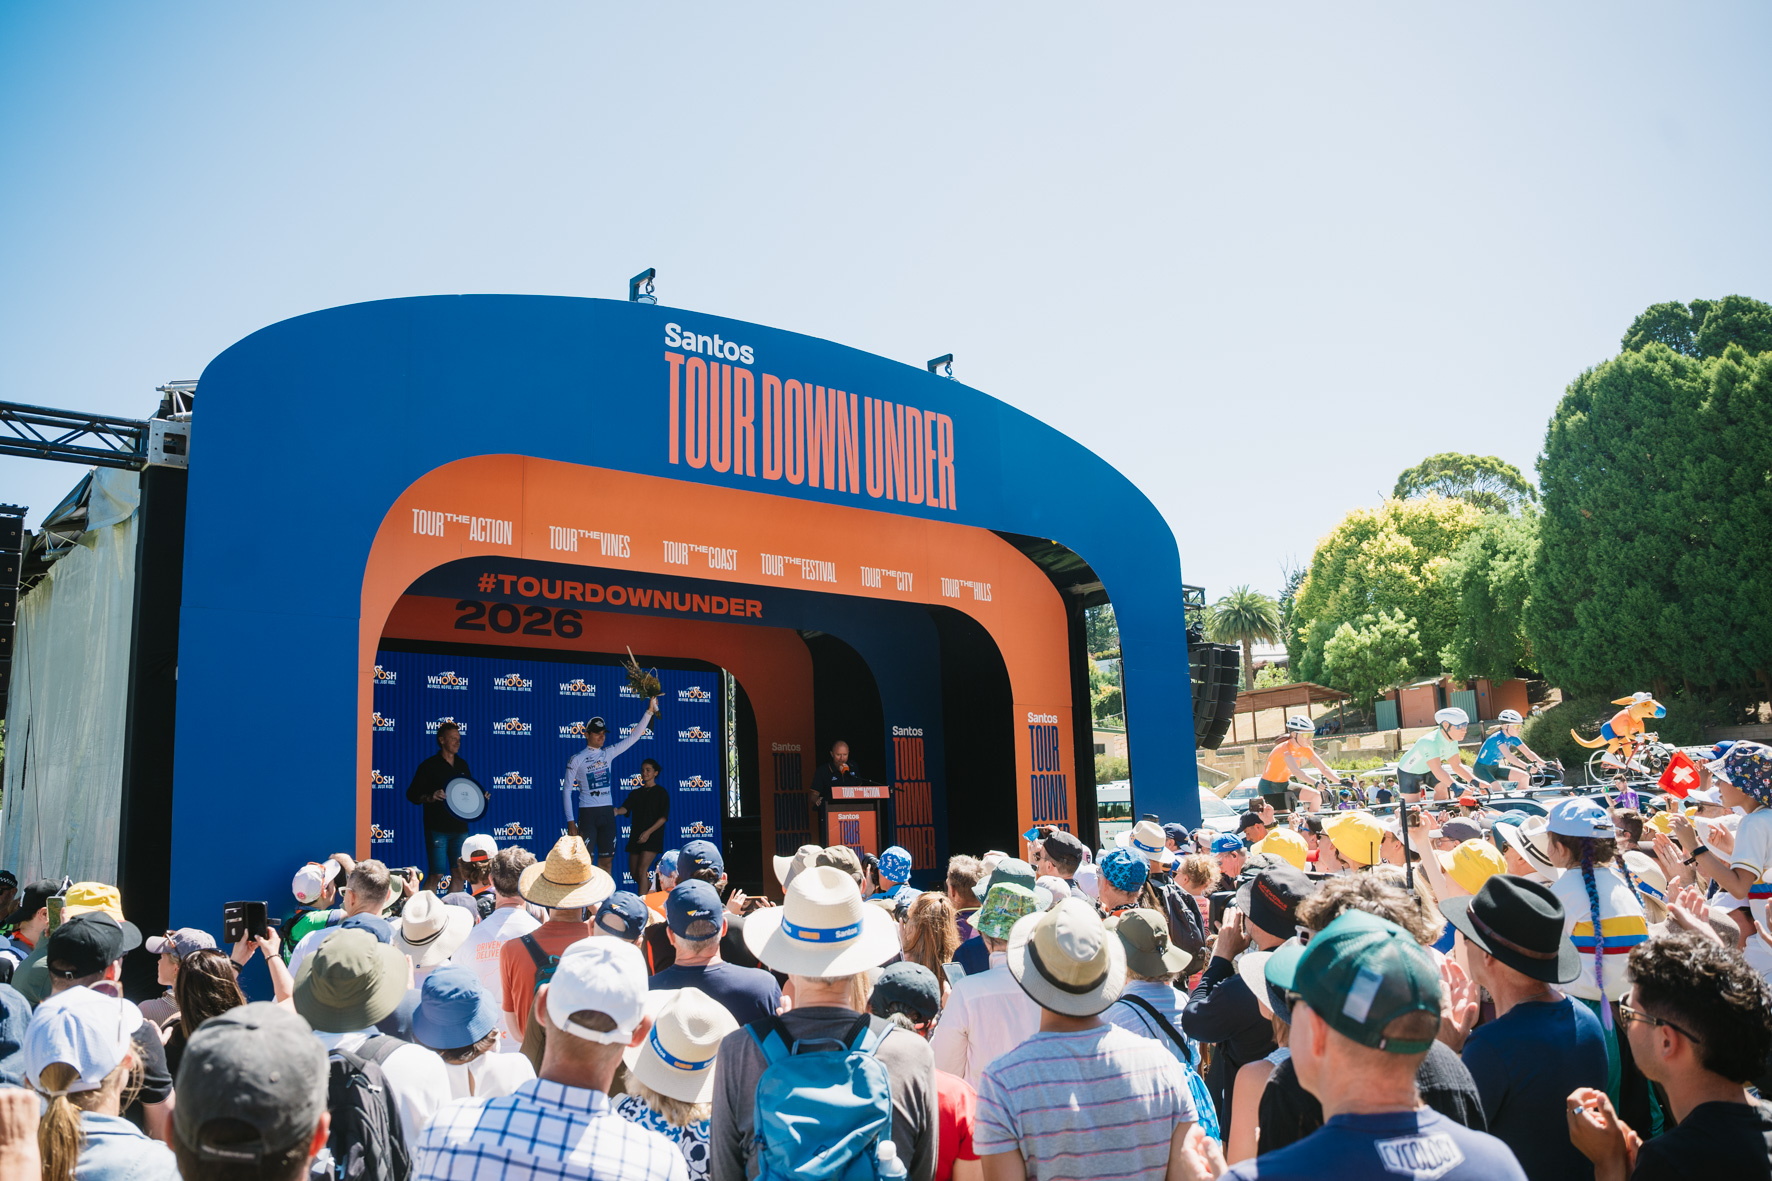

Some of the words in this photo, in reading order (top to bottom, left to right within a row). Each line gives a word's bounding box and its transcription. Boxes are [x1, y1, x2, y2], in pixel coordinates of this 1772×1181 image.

[664, 322, 754, 365] Santos
[664, 351, 756, 477] TOUR
[762, 373, 860, 494] DOWN
[864, 396, 957, 511] UNDER
[412, 508, 444, 537] TOUR
[445, 513, 470, 524] THE
[469, 516, 512, 545] ACTION
[549, 525, 578, 552] TOUR
[578, 529, 600, 540] THE
[600, 531, 630, 558] VINES
[663, 540, 688, 565] TOUR
[688, 543, 708, 554] THE
[708, 546, 737, 571] COAST
[761, 553, 784, 577] TOUR
[784, 556, 801, 565] THE
[801, 558, 837, 583] FESTIVAL
[860, 566, 881, 589] TOUR
[881, 569, 896, 578] THE
[896, 571, 913, 592] CITY
[941, 577, 960, 599] TOUR
[959, 579, 973, 588] THE
[973, 581, 992, 602] HILLS
[477, 572, 763, 618] #TOURDOWNUNDER
[454, 600, 583, 639] 2026
[374, 671, 396, 680] OSH
[427, 676, 468, 686] WHOOSH
[494, 677, 532, 687] WHOOSH
[560, 683, 596, 692] WHOOSH
[678, 690, 711, 699] WHOOSH
[376, 718, 395, 727] OSH
[1027, 712, 1058, 724] Santos
[426, 721, 467, 731] WHSH
[493, 722, 531, 731] WHOOSH
[559, 726, 586, 735] WHOO
[892, 725, 923, 736] Santos
[619, 727, 654, 736] WHSH
[678, 730, 711, 739] WHOOSH
[771, 742, 801, 752] Santos
[1028, 725, 1060, 772] TOUR
[892, 737, 925, 781] TOUR
[772, 753, 803, 791] TOUR
[375, 776, 394, 784] OSH
[493, 776, 532, 785] WHOOSH
[620, 778, 645, 786] WHOO
[679, 780, 712, 788] WHOOSH
[842, 787, 854, 797] TOUR
[864, 787, 880, 797] ACTION
[1030, 774, 1068, 822] DOWN
[894, 782, 933, 826] DOWN
[774, 792, 810, 831] DOWN
[375, 829, 394, 839] OSH
[493, 827, 533, 836] WHOOSH
[680, 826, 714, 834] WHOOSH
[839, 820, 860, 845] TOUR
[835, 927, 858, 938] Santos
[476, 941, 501, 951] DRIVEN
[476, 949, 500, 959] DELIVE
